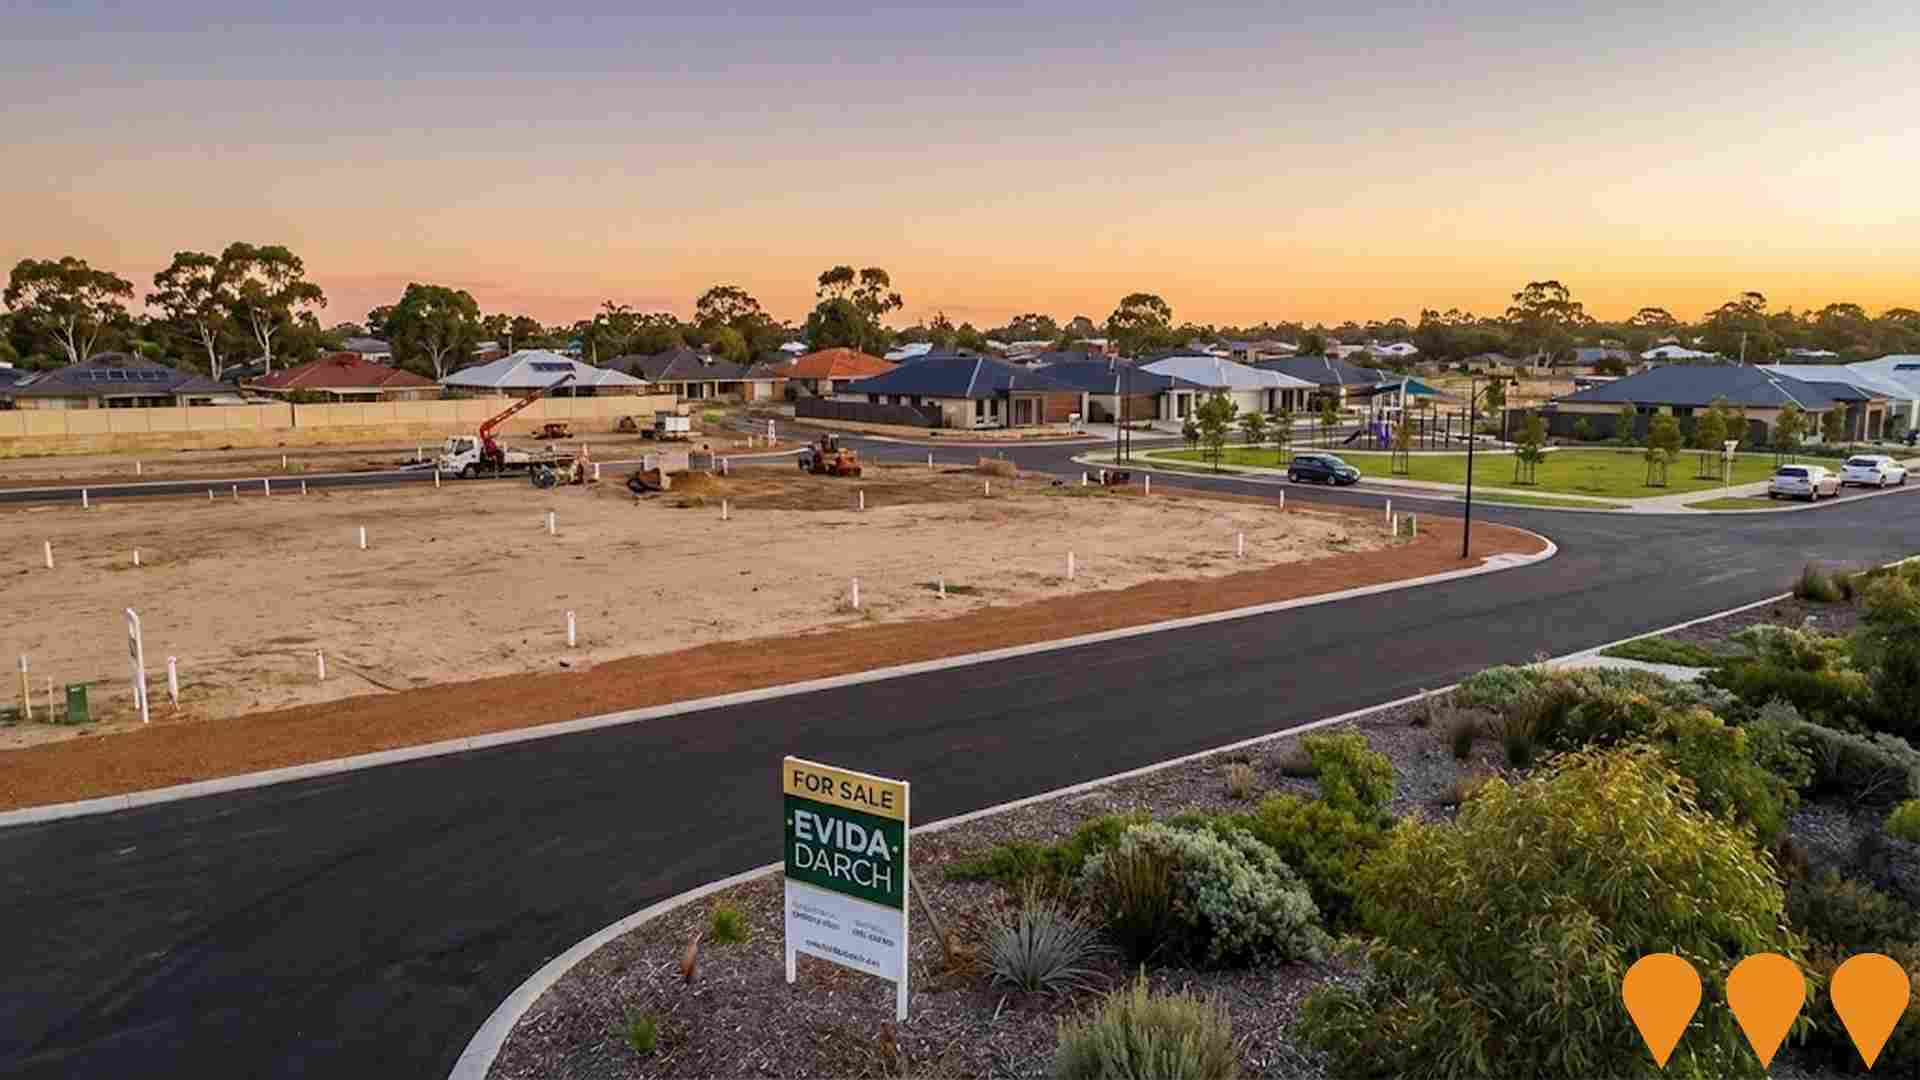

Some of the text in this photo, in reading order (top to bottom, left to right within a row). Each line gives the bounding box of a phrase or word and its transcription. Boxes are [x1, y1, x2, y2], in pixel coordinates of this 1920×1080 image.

[793, 770, 894, 809] FOR SALE
[794, 809, 891, 861] EVIDA
[795, 842, 891, 893] DARCH
